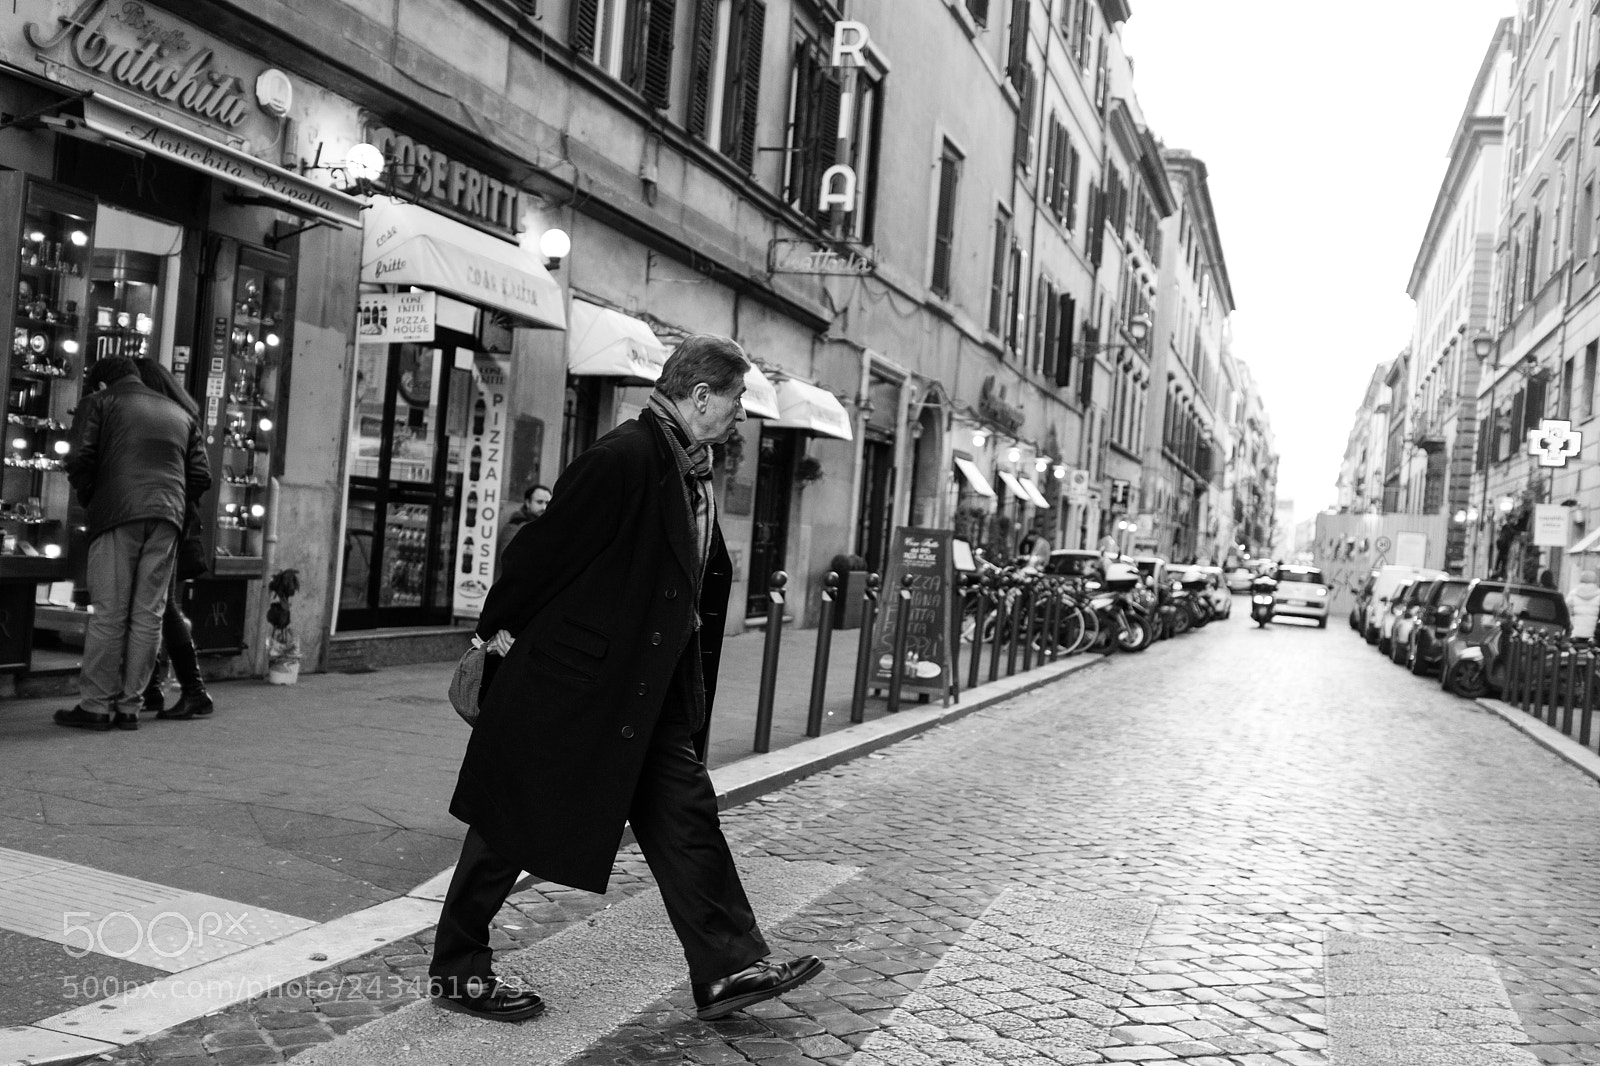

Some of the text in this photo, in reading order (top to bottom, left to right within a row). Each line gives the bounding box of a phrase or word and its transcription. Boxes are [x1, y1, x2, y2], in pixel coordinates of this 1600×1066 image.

[125, 125, 334, 211] Antichità Ripetta
[371, 127, 447, 199] COSE
[393, 324, 430, 334] HOUSE
[395, 315, 427, 325] PIZZA
[485, 393, 504, 480] PIZZA
[479, 489, 496, 576] HOUSE
